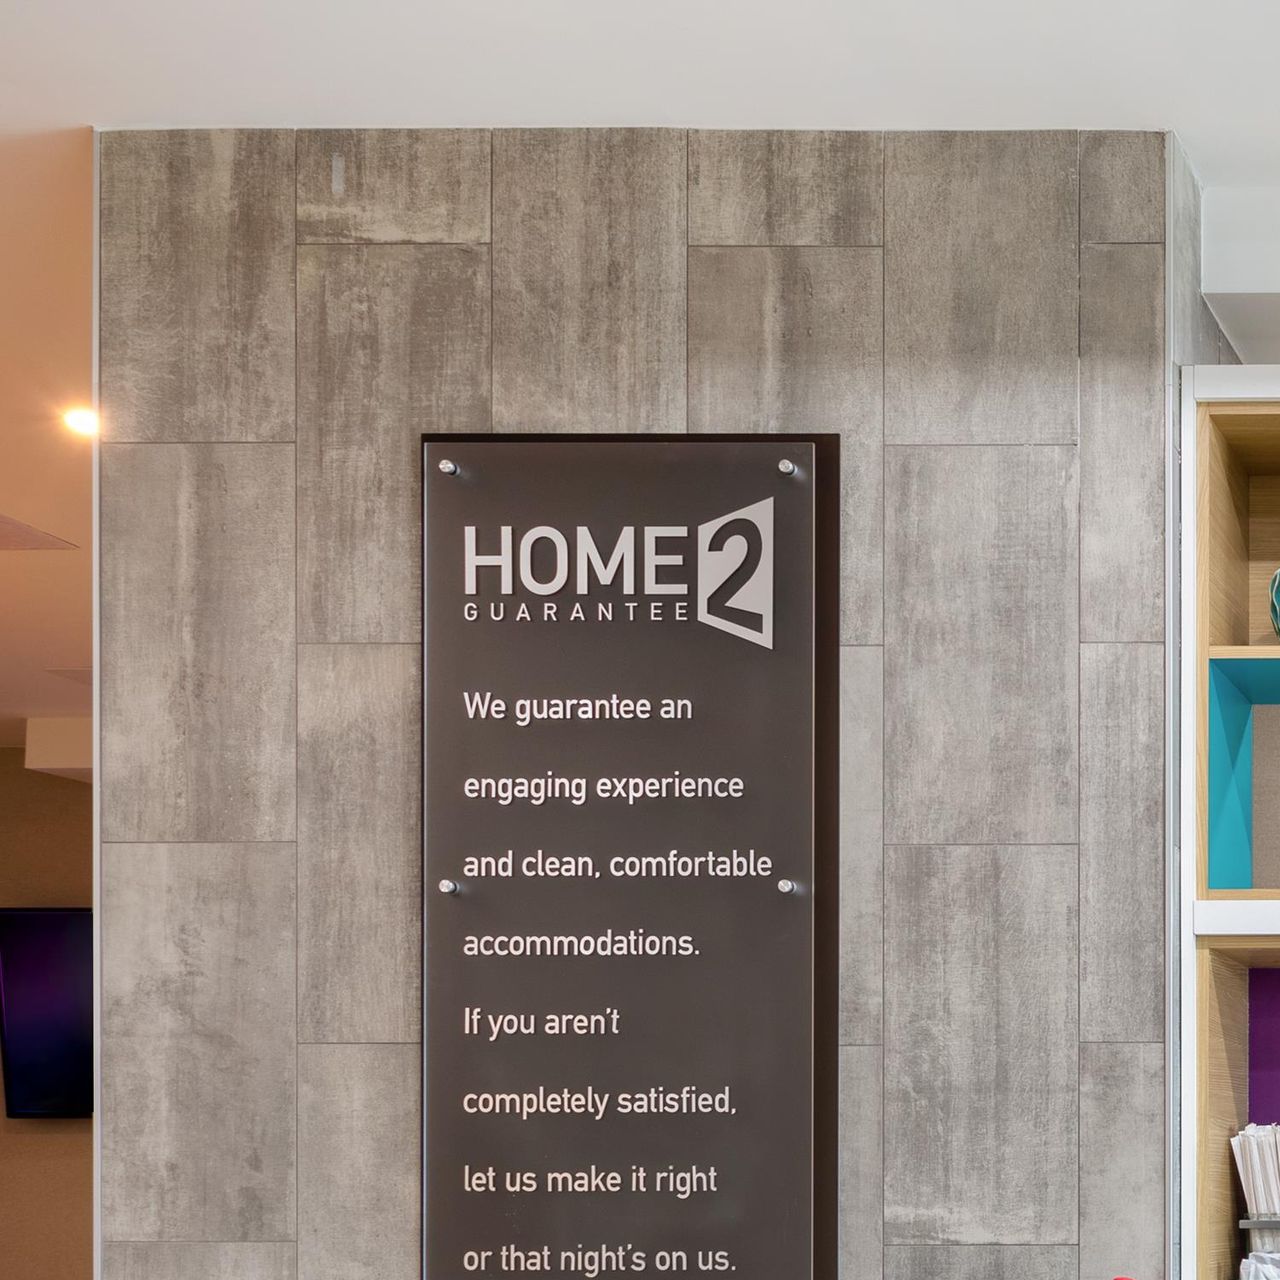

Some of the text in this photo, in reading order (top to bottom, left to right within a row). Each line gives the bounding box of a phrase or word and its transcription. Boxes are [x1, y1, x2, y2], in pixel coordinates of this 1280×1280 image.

[463, 603, 689, 622] GUARANTEE
[463, 691, 692, 727] We guarantee an
[463, 770, 744, 806] engaging experience
[463, 849, 773, 880] and clean, comfortable
[463, 928, 700, 956] accommodations.
[464, 1007, 620, 1042] If you aren't
[463, 1085, 737, 1121] completely satisfied,
[464, 1164, 717, 1200] let us make it right
[463, 1243, 737, 1278] or that night's on us.
